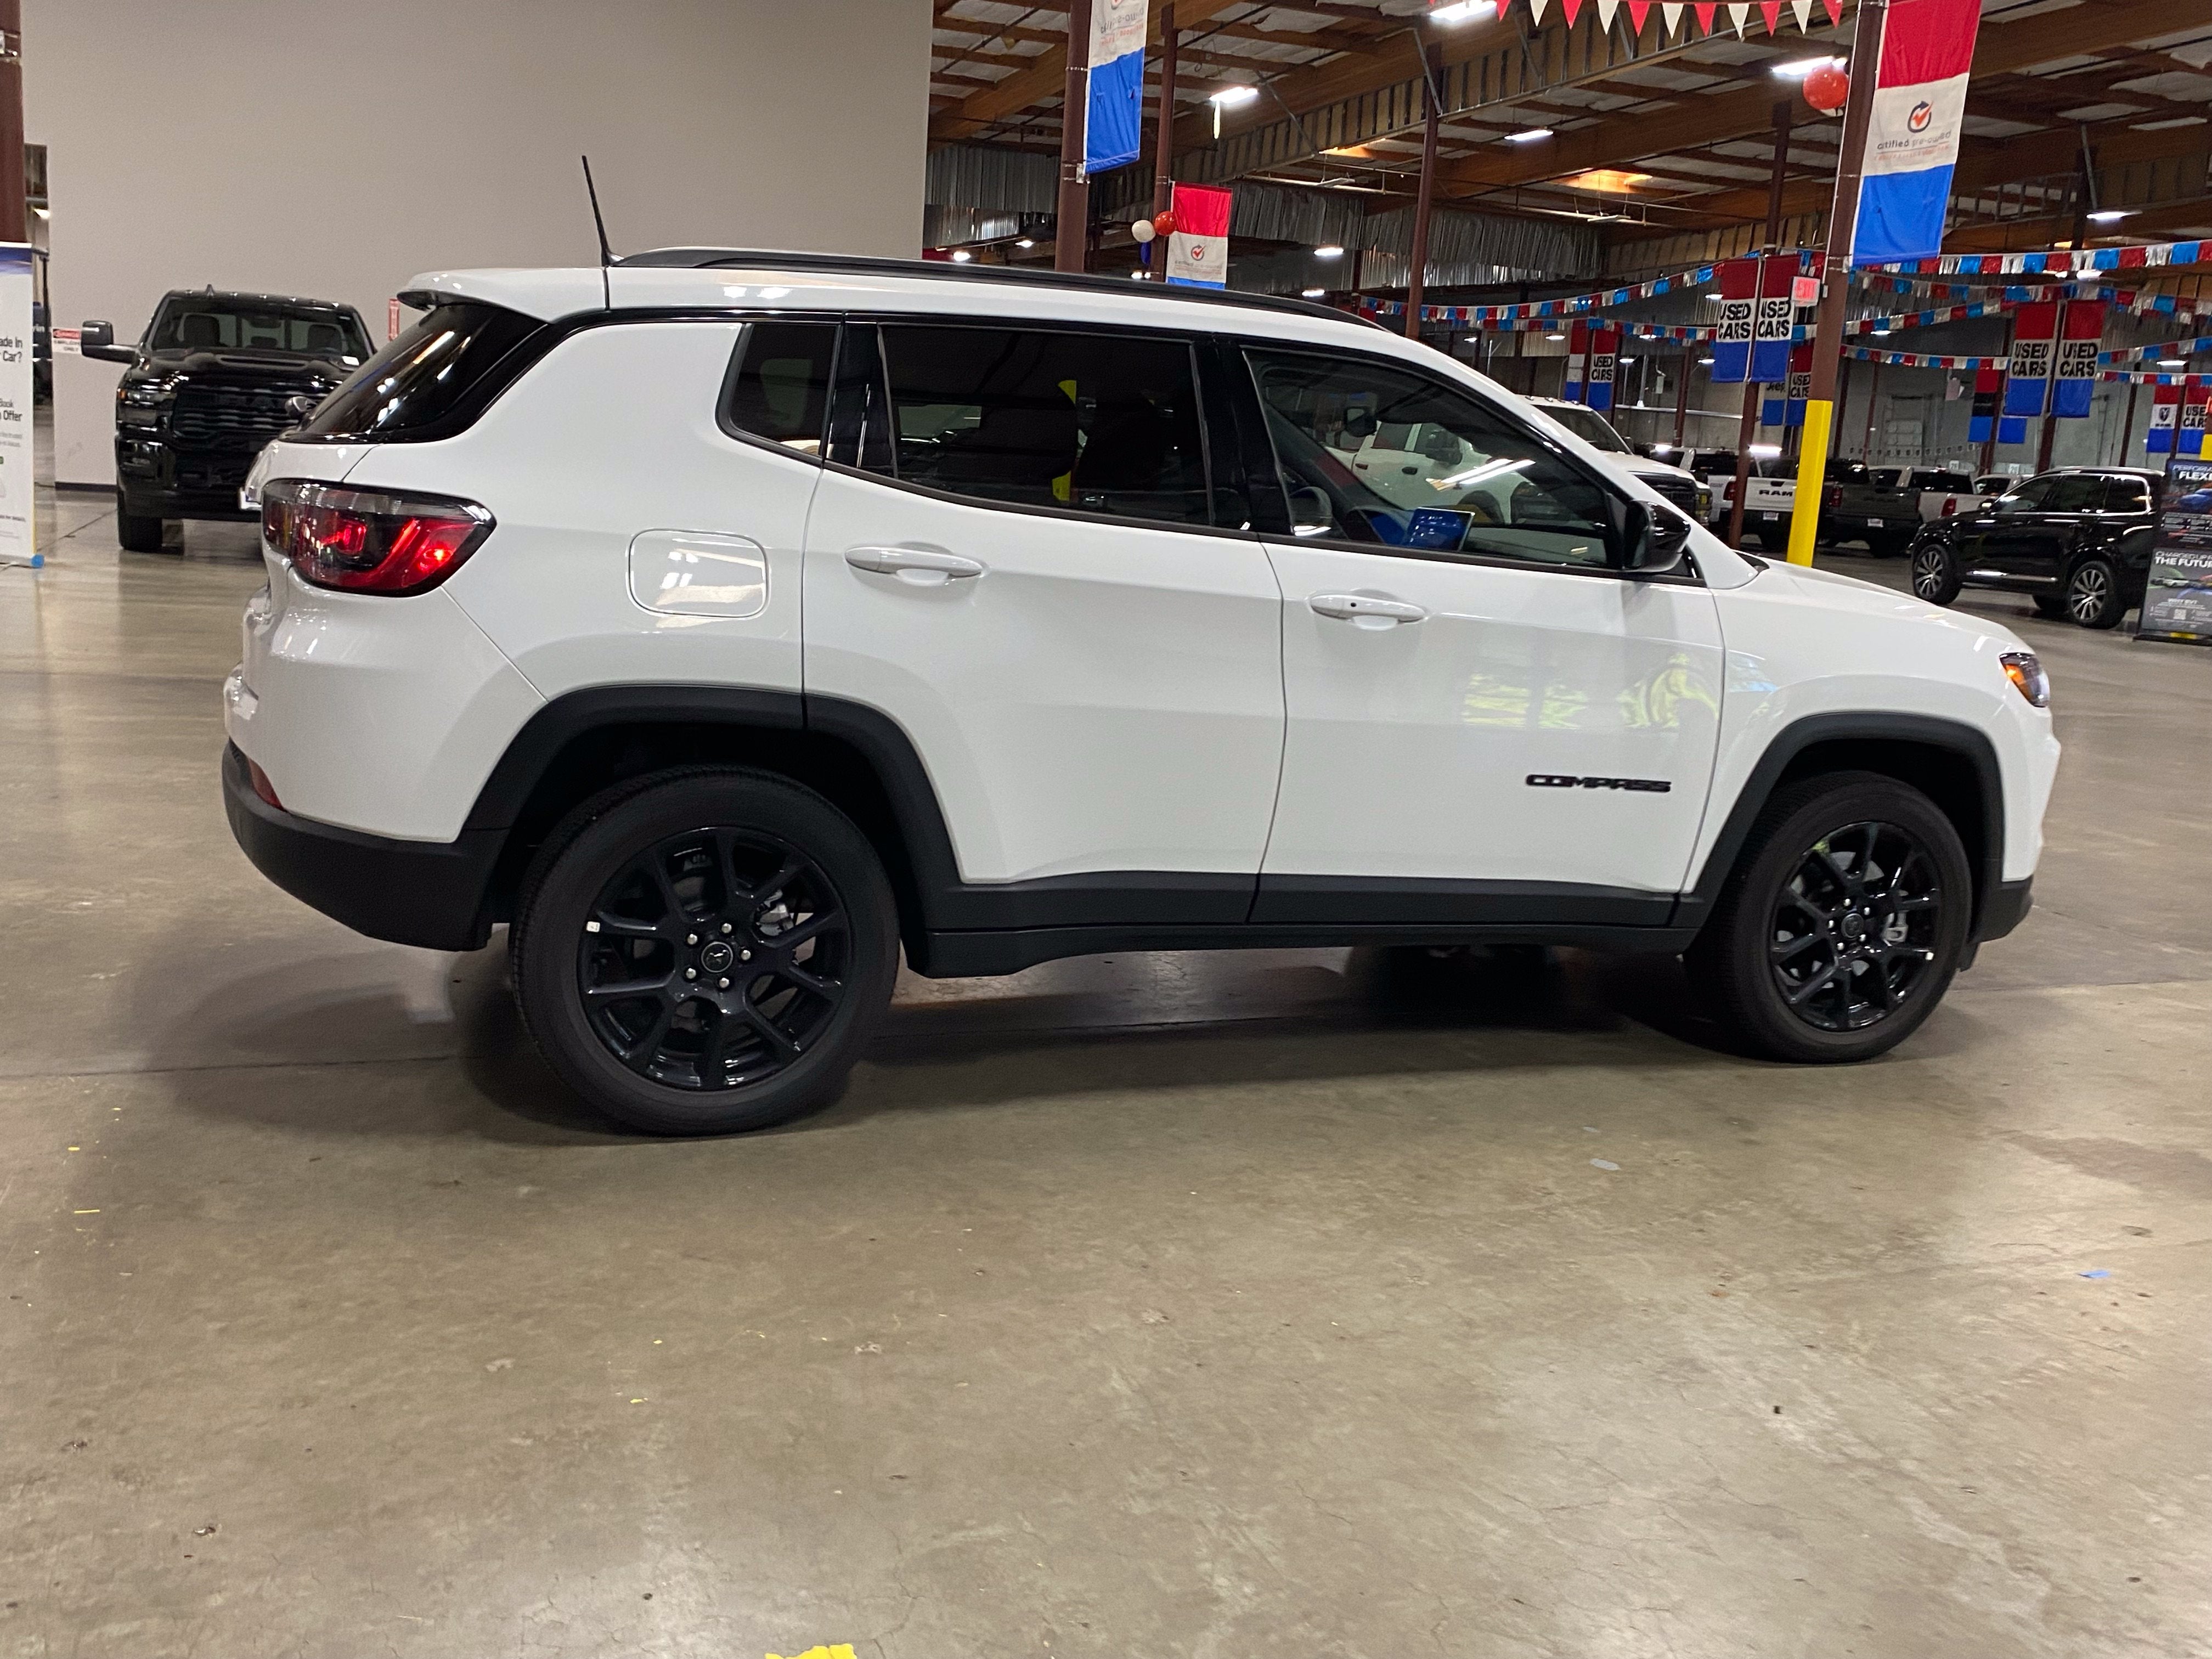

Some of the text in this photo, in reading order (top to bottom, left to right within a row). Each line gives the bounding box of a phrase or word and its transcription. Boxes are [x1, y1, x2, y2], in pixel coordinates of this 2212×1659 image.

[1720, 303, 1751, 320] USED
[1760, 301, 1791, 318] USED
[1718, 321, 1751, 339] CARS
[1757, 319, 1790, 338] CARS
[0, 336, 13, 347] ade
[2015, 342, 2049, 358] USED
[1593, 356, 1613, 367] USED
[2012, 360, 2047, 376] CARS
[2059, 360, 2096, 377] CARS
[2186, 406, 2207, 416] USE
[2155, 556, 2177, 566] THE
[1526, 774, 1671, 792] COMPASS
